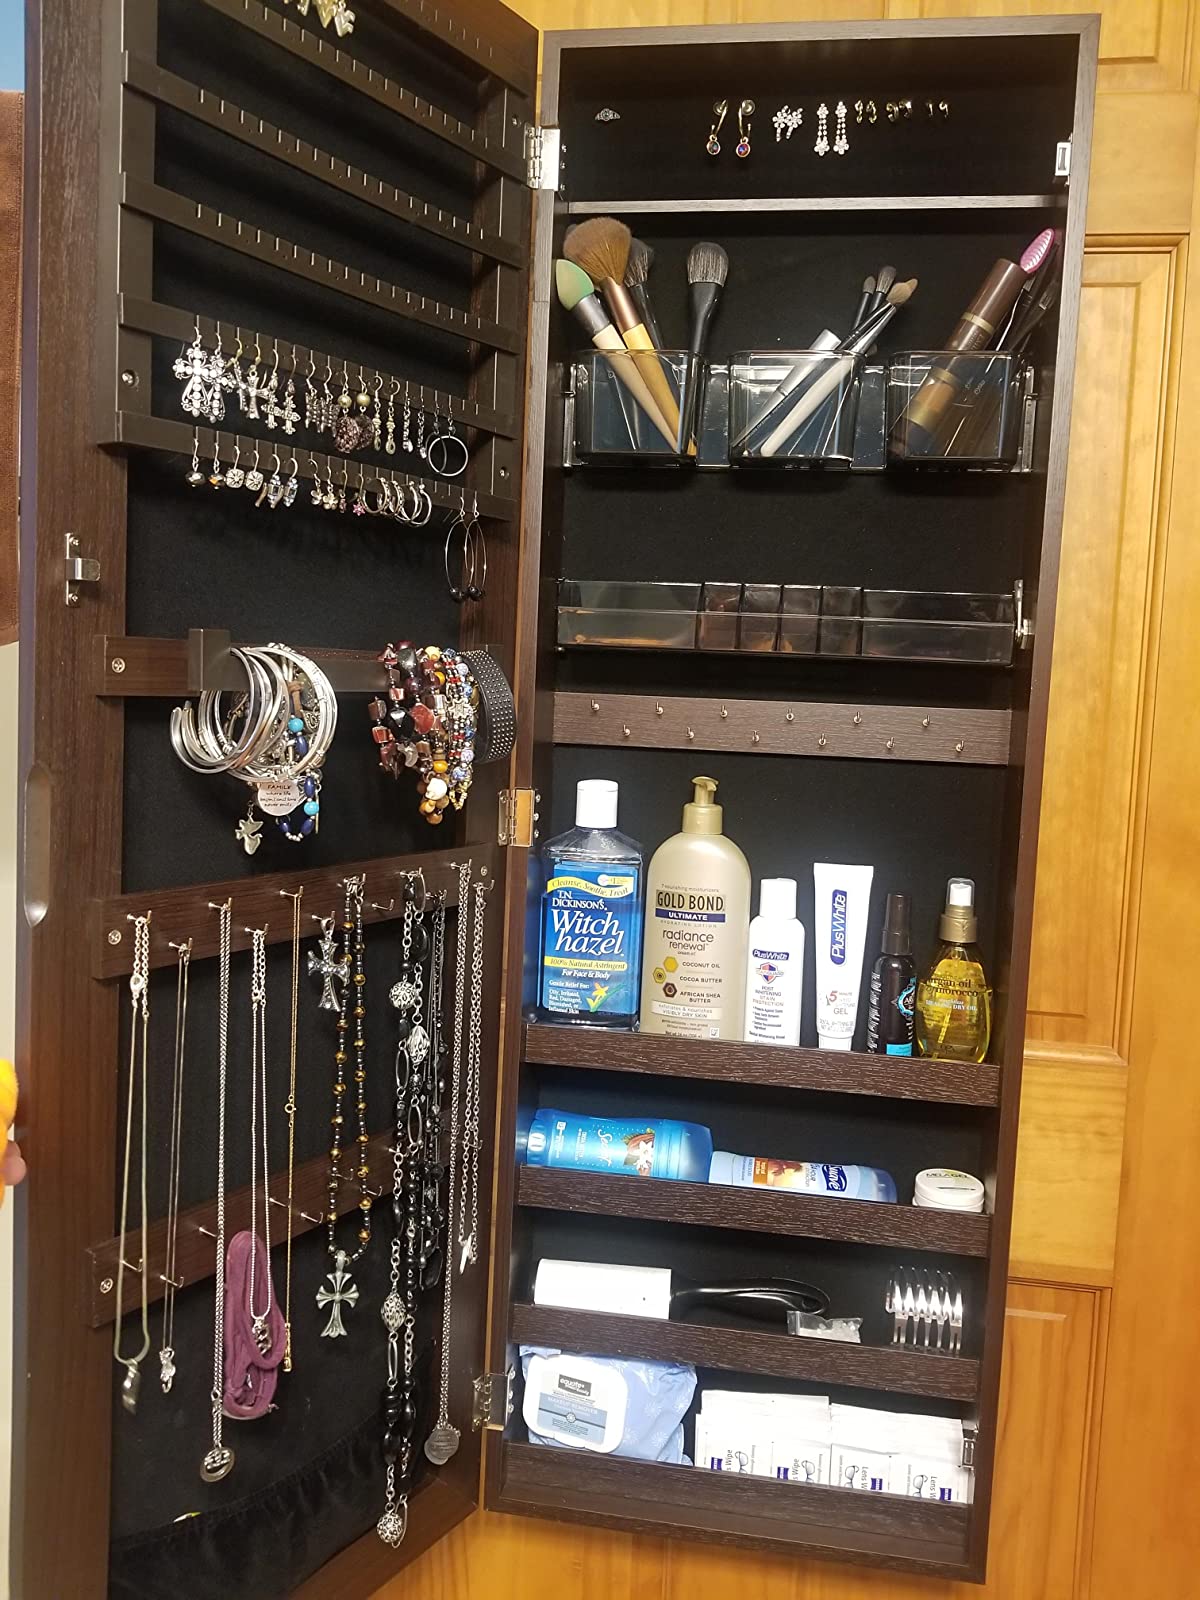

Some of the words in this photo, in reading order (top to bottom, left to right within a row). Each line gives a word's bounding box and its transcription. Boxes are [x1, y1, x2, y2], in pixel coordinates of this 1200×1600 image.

[657, 891, 685, 909] GOLD
[689, 895, 724, 911] BOND
[551, 909, 620, 935] Witch
[668, 912, 708, 921] ULTIMATE
[832, 892, 847, 959] PlusWhite
[555, 928, 624, 956] hazel
[662, 929, 714, 943] radiance
[669, 941, 706, 952] renewal
[568, 960, 593, 968] Natural
[593, 961, 625, 970] Astringent
[573, 970, 587, 978] Face
[595, 972, 611, 980] Body
[597, 1129, 613, 1168] Set
[828, 1165, 843, 1190] Suave
[725, 1449, 733, 1466] Wipe
[792, 1458, 800, 1477] Wipe
[930, 1476, 938, 1491] Lens
